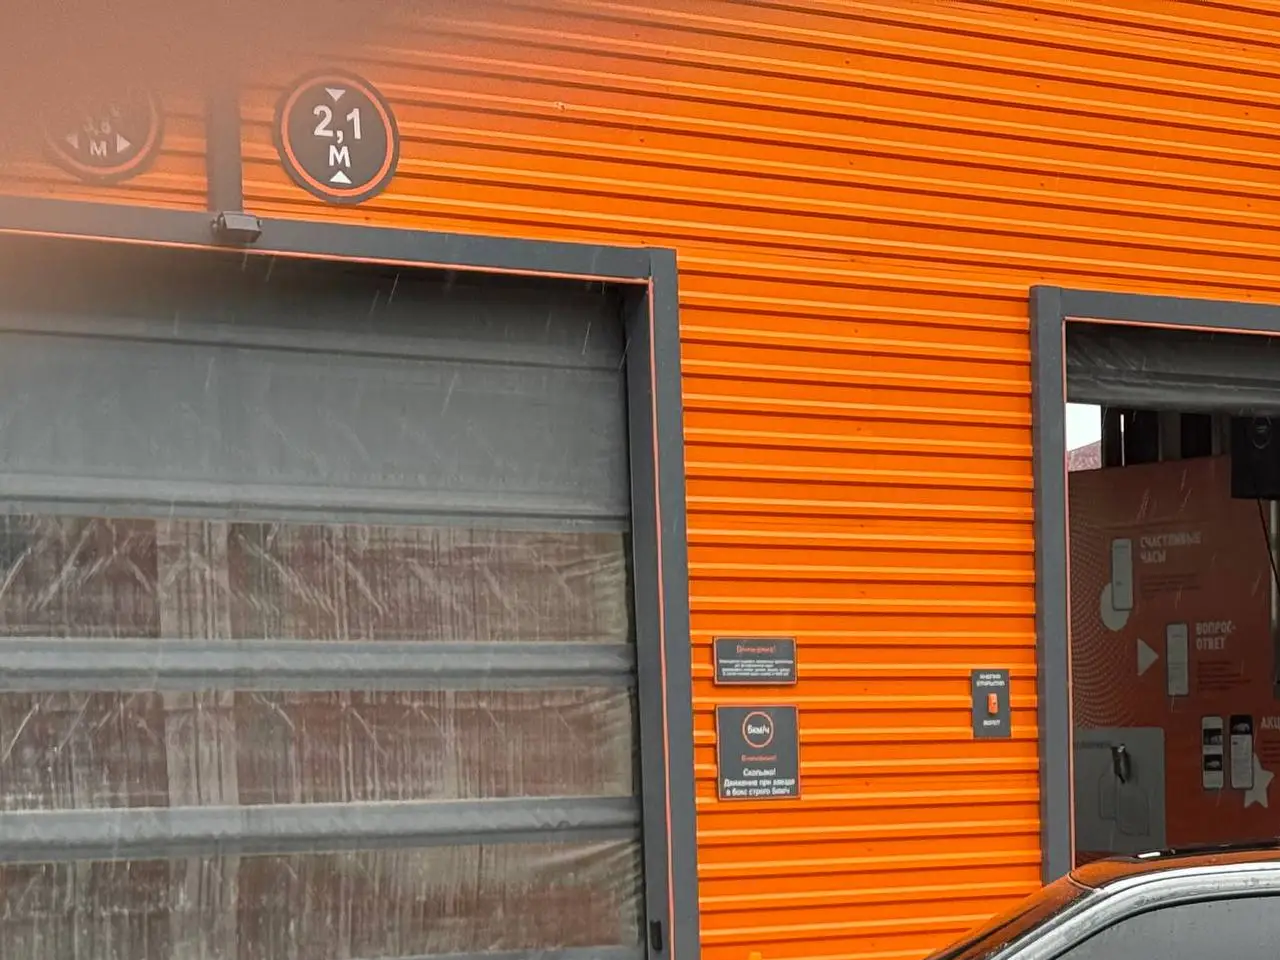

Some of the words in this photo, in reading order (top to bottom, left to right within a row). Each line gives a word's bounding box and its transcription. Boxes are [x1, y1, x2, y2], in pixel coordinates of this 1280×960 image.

[312, 104, 362, 144] 2,1
[328, 144, 351, 168] М
[1196, 636, 1225, 651] ОТВЕТ
